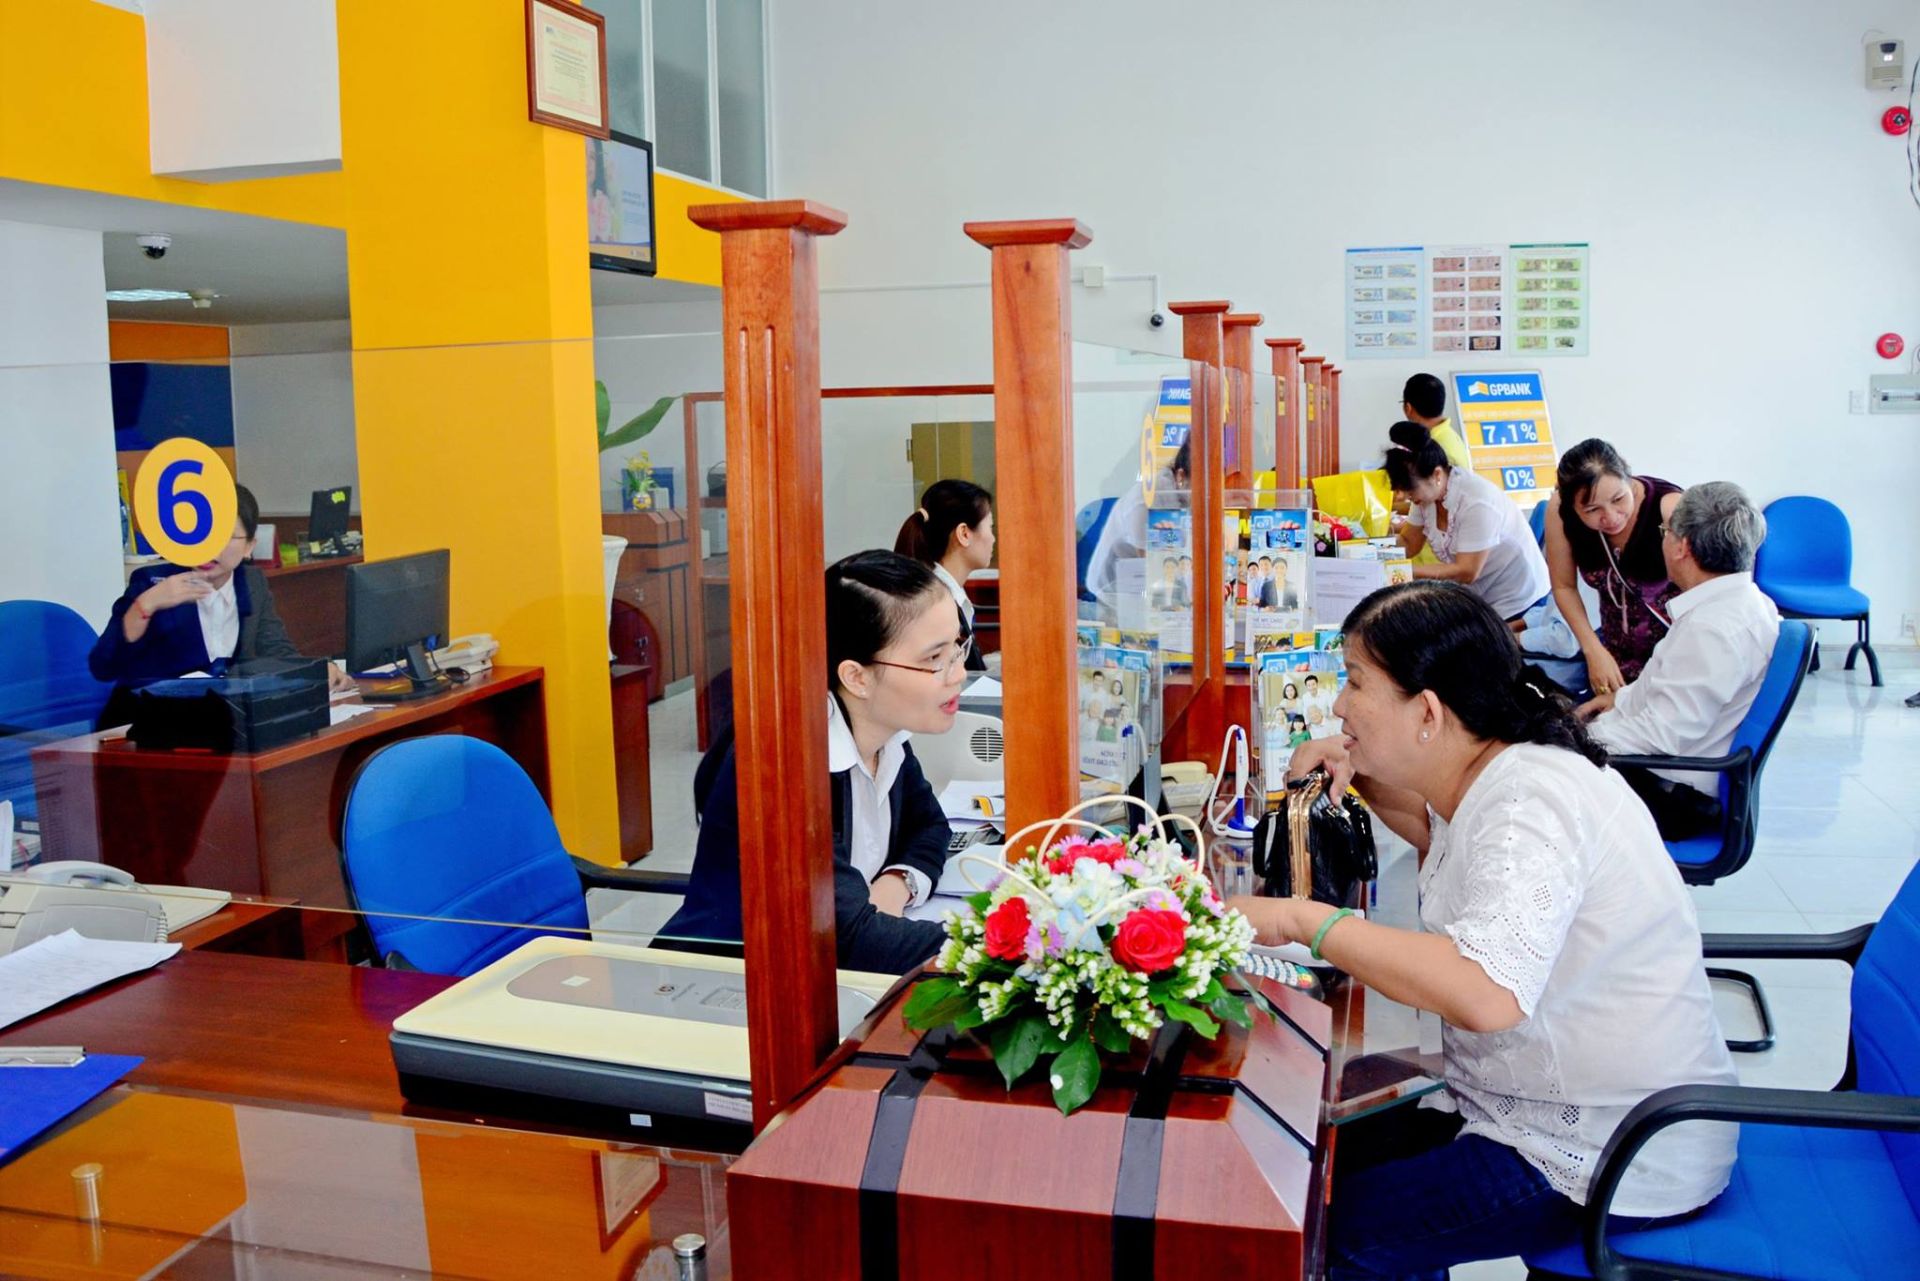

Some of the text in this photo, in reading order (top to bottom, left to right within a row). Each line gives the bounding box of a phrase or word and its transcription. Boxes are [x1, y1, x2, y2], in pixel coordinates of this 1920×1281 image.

[1489, 382, 1532, 396] GPBANK
[1482, 423, 1537, 444] 7,1%
[1505, 469, 1535, 488] 0%
[157, 459, 213, 546] 6
